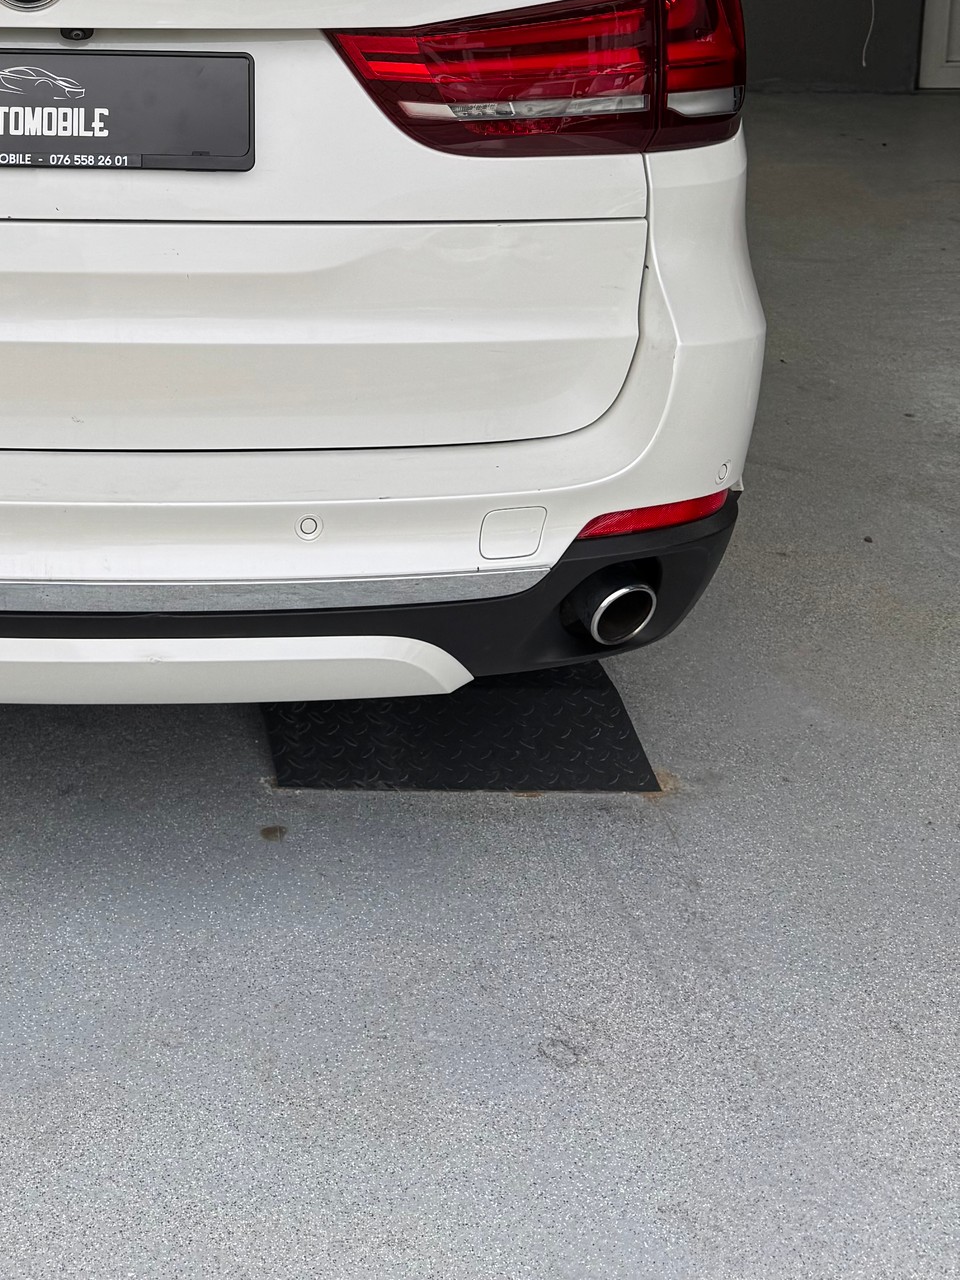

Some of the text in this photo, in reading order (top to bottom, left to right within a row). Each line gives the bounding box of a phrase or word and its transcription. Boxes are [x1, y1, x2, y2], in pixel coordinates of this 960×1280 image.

[49, 154, 71, 166] 076
[73, 155, 95, 166] 558
[97, 155, 113, 166] 26
[114, 155, 128, 167] 01
